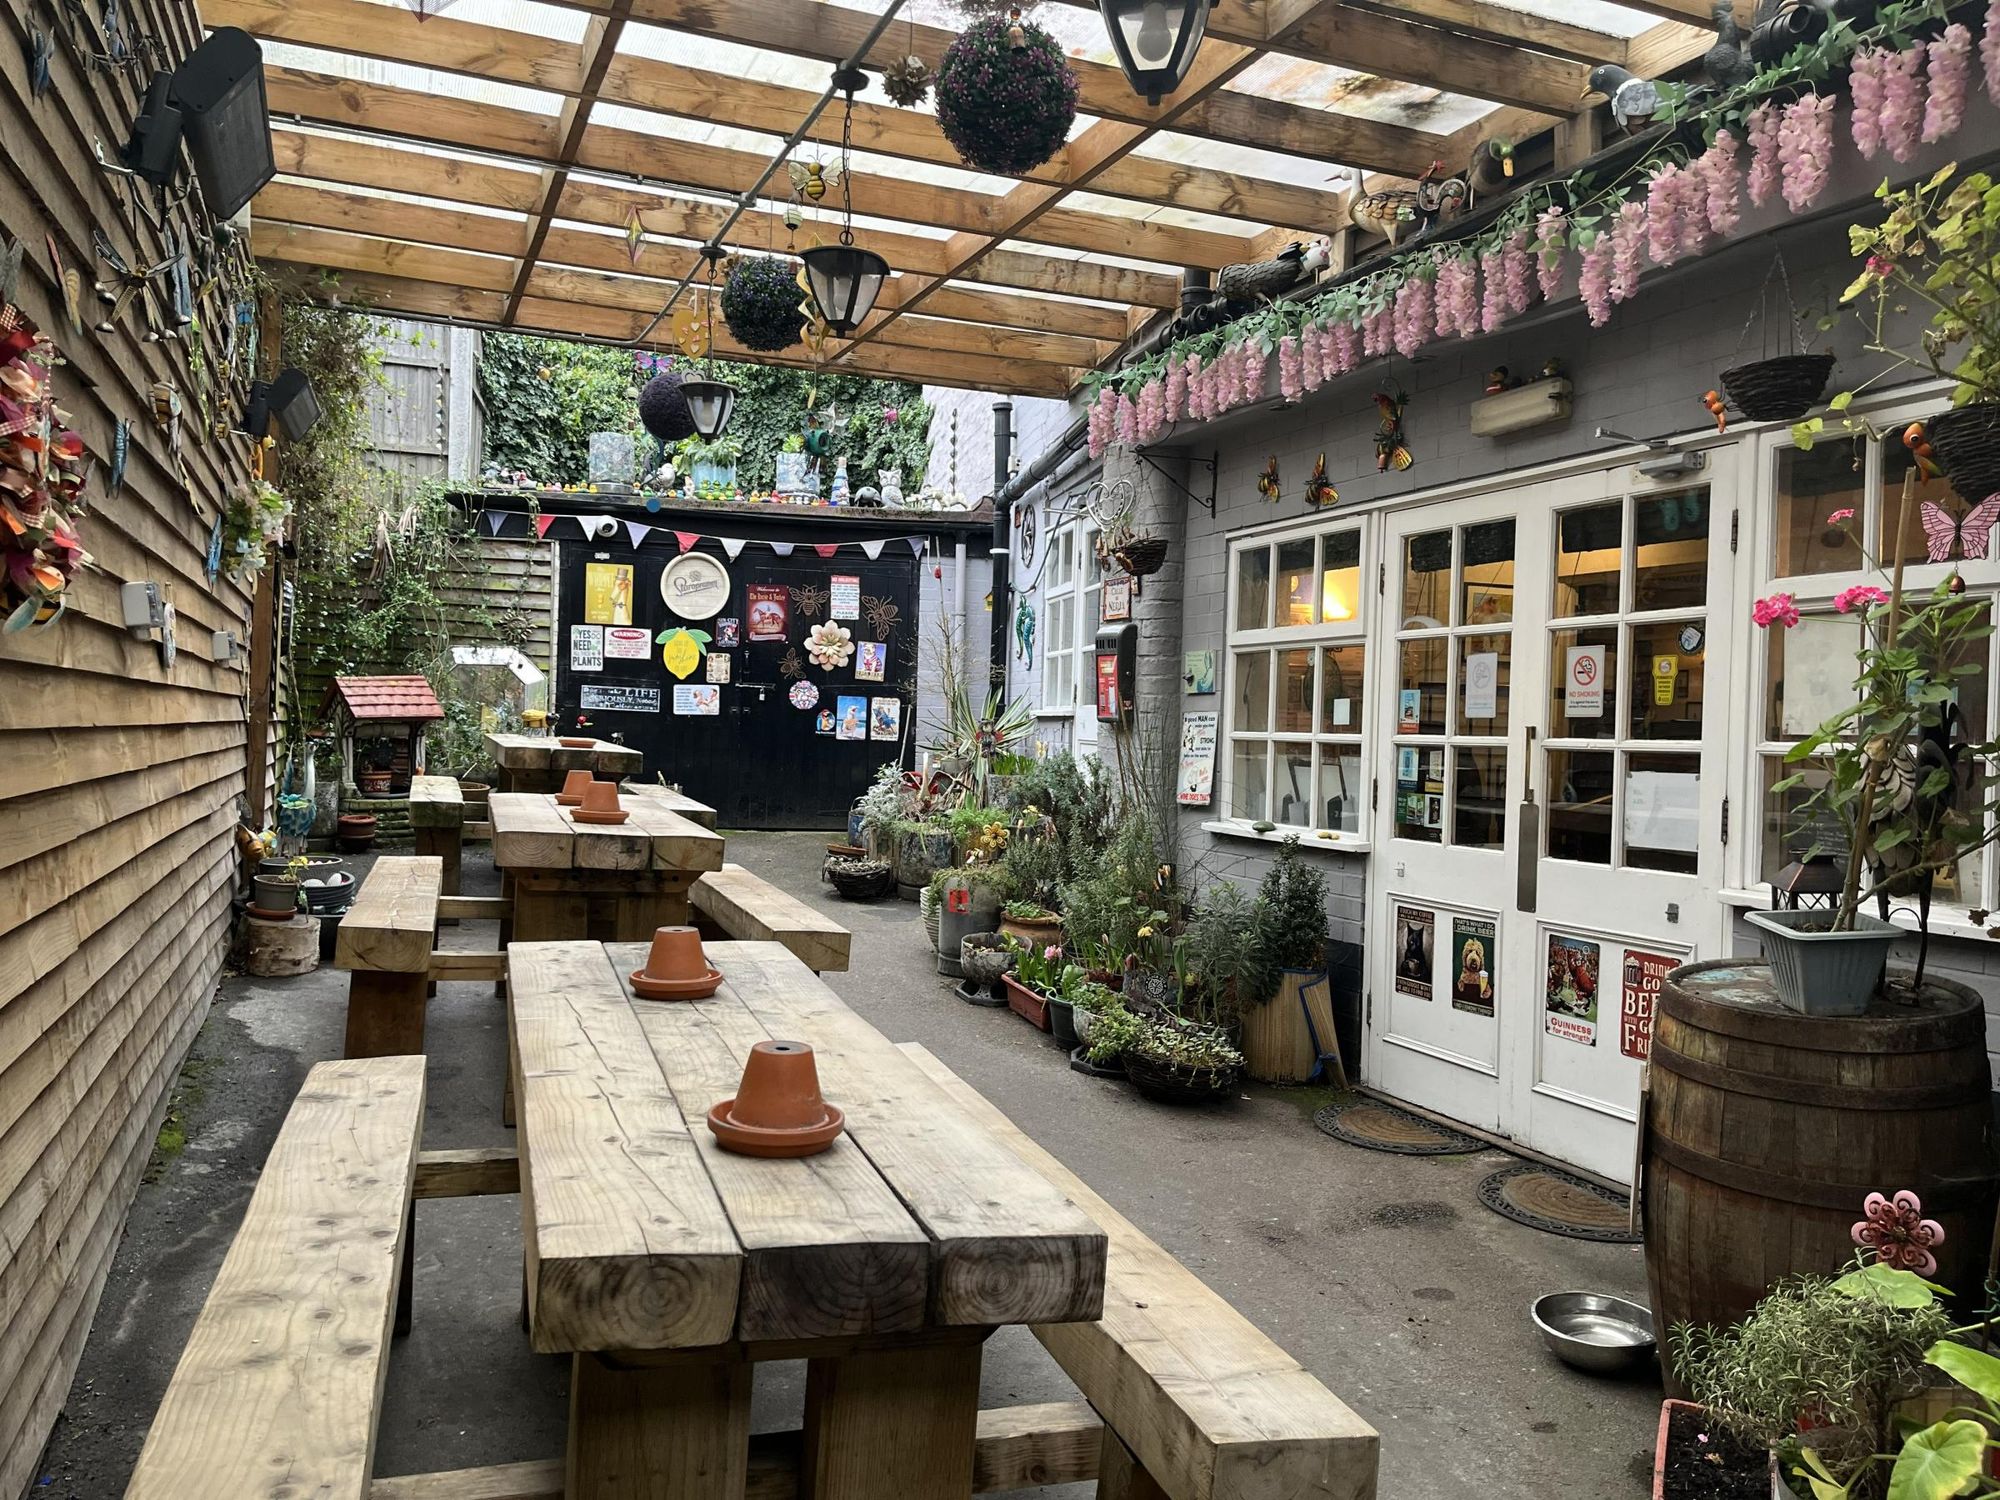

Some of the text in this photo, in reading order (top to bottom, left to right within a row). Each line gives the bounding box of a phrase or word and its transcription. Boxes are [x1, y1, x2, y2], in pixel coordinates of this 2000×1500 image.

[579, 630, 591, 639] YES
[573, 640, 591, 650] NEED
[573, 657, 601, 666] PLANTS
[626, 689, 657, 697] LIFE
[1643, 977, 1660, 990] GO
[1624, 989, 1660, 1017] BEE
[1551, 1017, 1592, 1035] GUINNESS
[1563, 1030, 1590, 1042] strength
[1624, 1024, 1648, 1054] FRI
